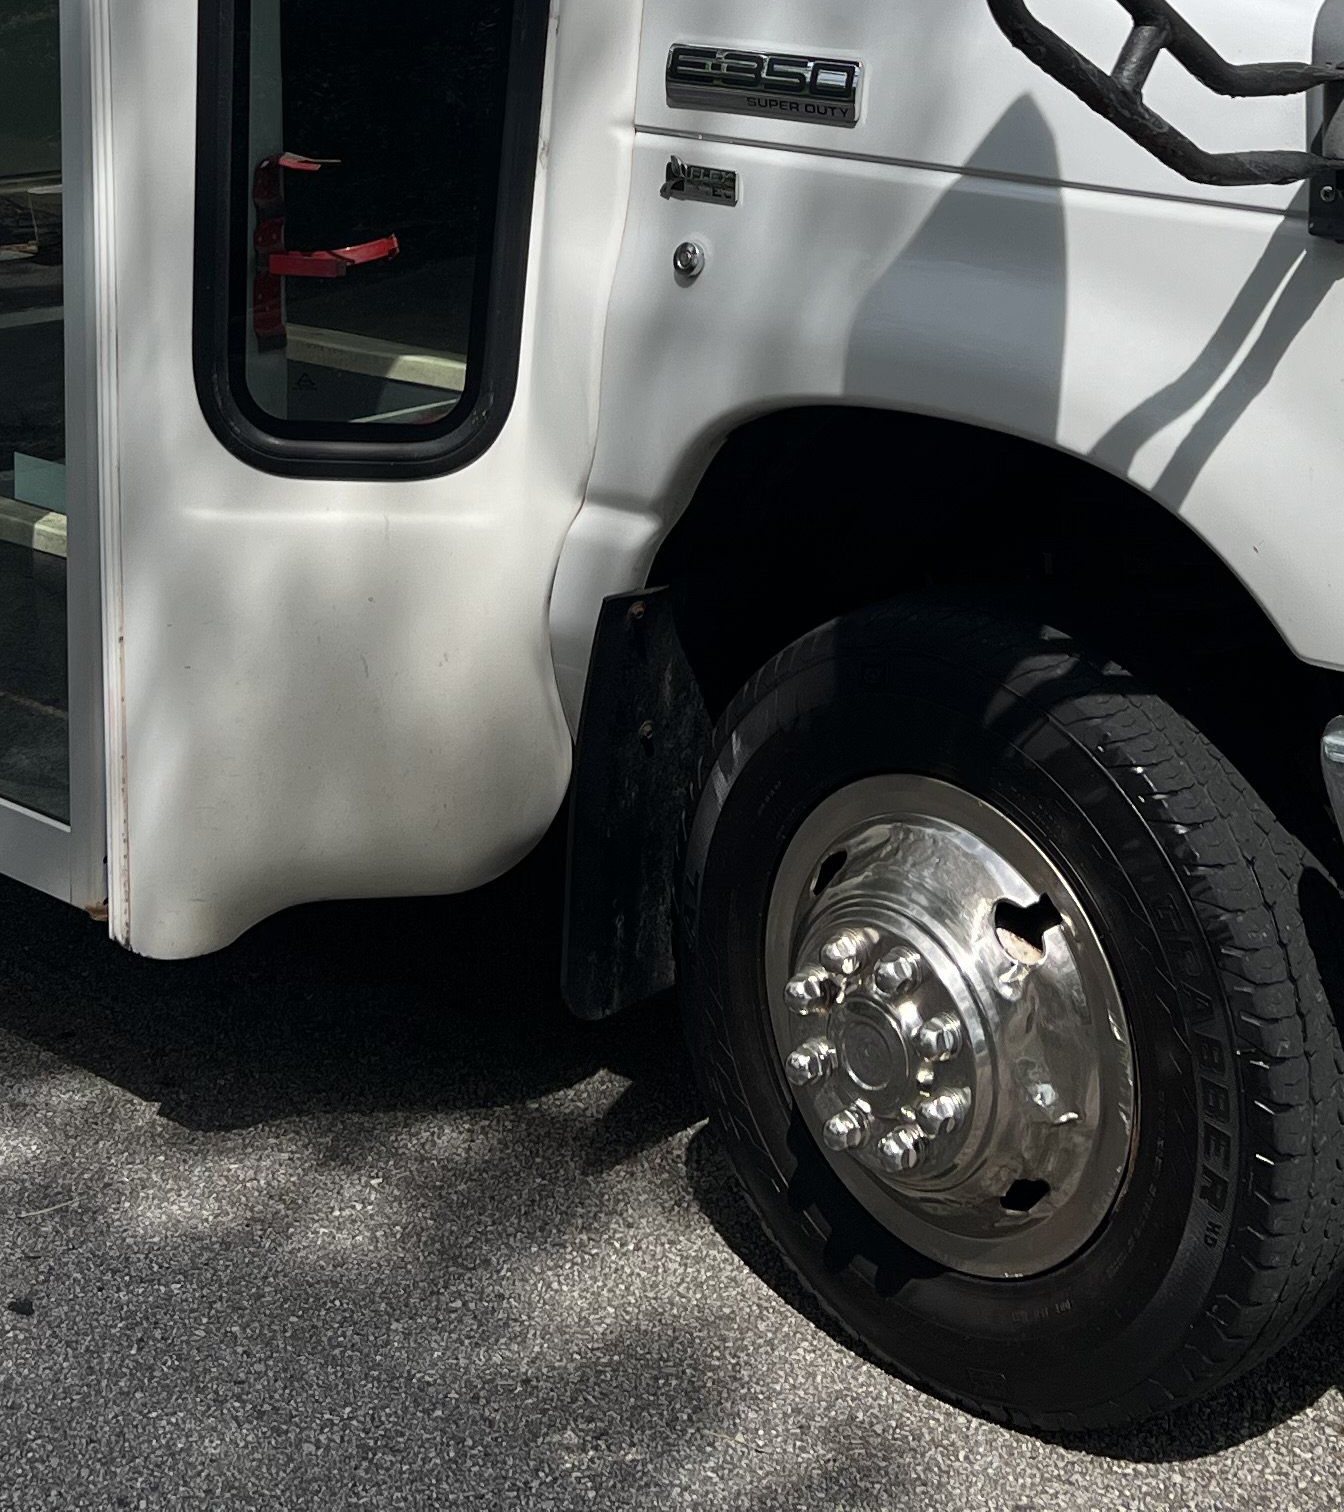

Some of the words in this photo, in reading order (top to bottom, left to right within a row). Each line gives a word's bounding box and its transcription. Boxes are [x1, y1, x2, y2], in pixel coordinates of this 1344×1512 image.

[746, 96, 800, 113] SUPER
[804, 103, 849, 118] DUTY
[1203, 1221, 1223, 1249] HD
